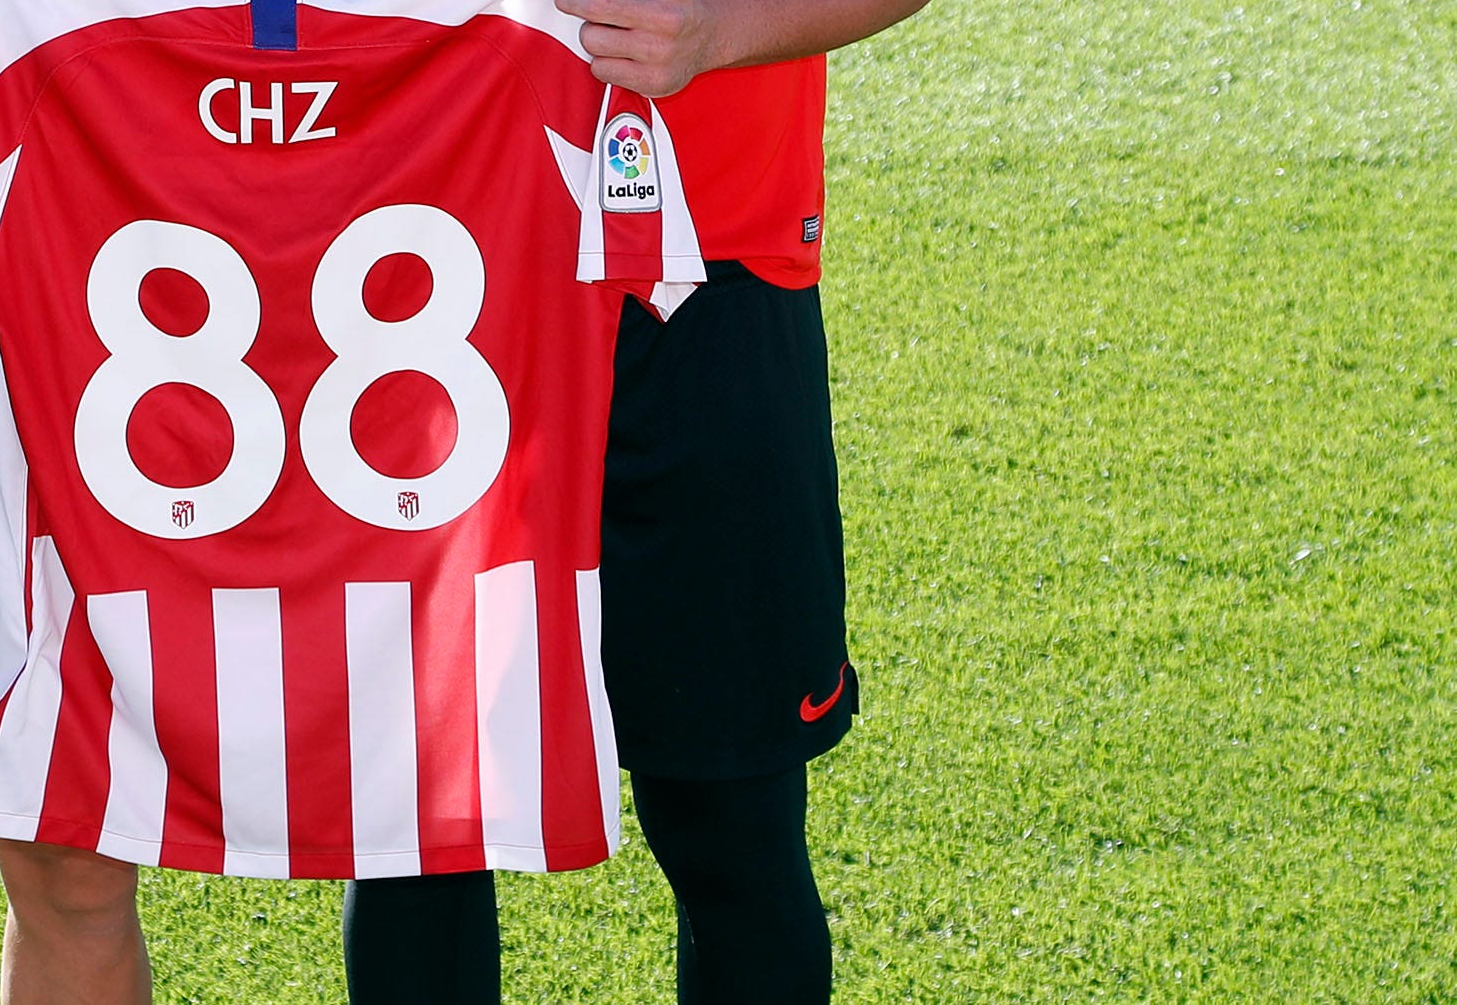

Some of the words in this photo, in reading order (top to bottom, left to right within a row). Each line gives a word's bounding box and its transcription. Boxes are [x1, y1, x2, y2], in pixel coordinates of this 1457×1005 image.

[198, 77, 340, 146] CHZ
[608, 183, 655, 200] LaLiga
[74, 203, 511, 540] 88
